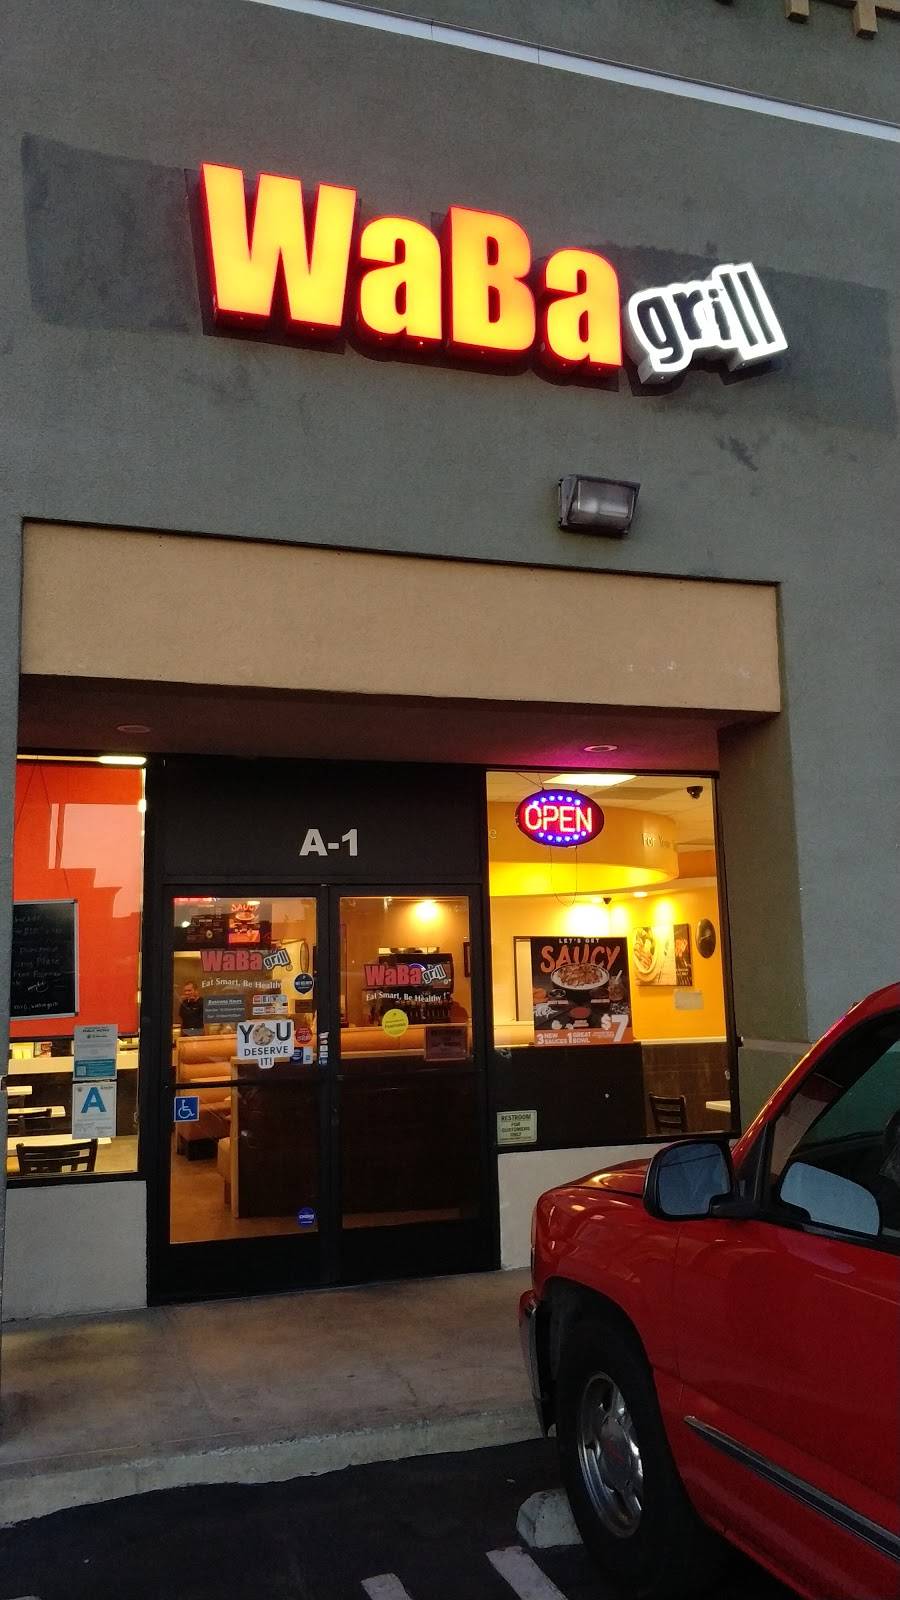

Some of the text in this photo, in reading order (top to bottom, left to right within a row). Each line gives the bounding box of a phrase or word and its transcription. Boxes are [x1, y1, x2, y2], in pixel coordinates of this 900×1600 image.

[202, 160, 788, 376] WaBa grill
[524, 804, 592, 833] OPEN
[299, 828, 358, 857] A-1
[201, 948, 291, 972] WaBa grill
[540, 944, 620, 973] SAUCY
[201, 980, 214, 988] Eat
[215, 978, 241, 986] Smart,
[243, 980, 253, 988] Be
[364, 964, 447, 986] WaBa grill
[366, 993, 377, 1001] Eat
[379, 991, 402, 1000] Smart,
[536, 1033, 544, 1045] 3
[601, 1013, 629, 1042] $7
[244, 1046, 289, 1057] DESERVE
[260, 1057, 273, 1066] IT!
[80, 1086, 107, 1114] A
[501, 1113, 532, 1121] RESTROOM
